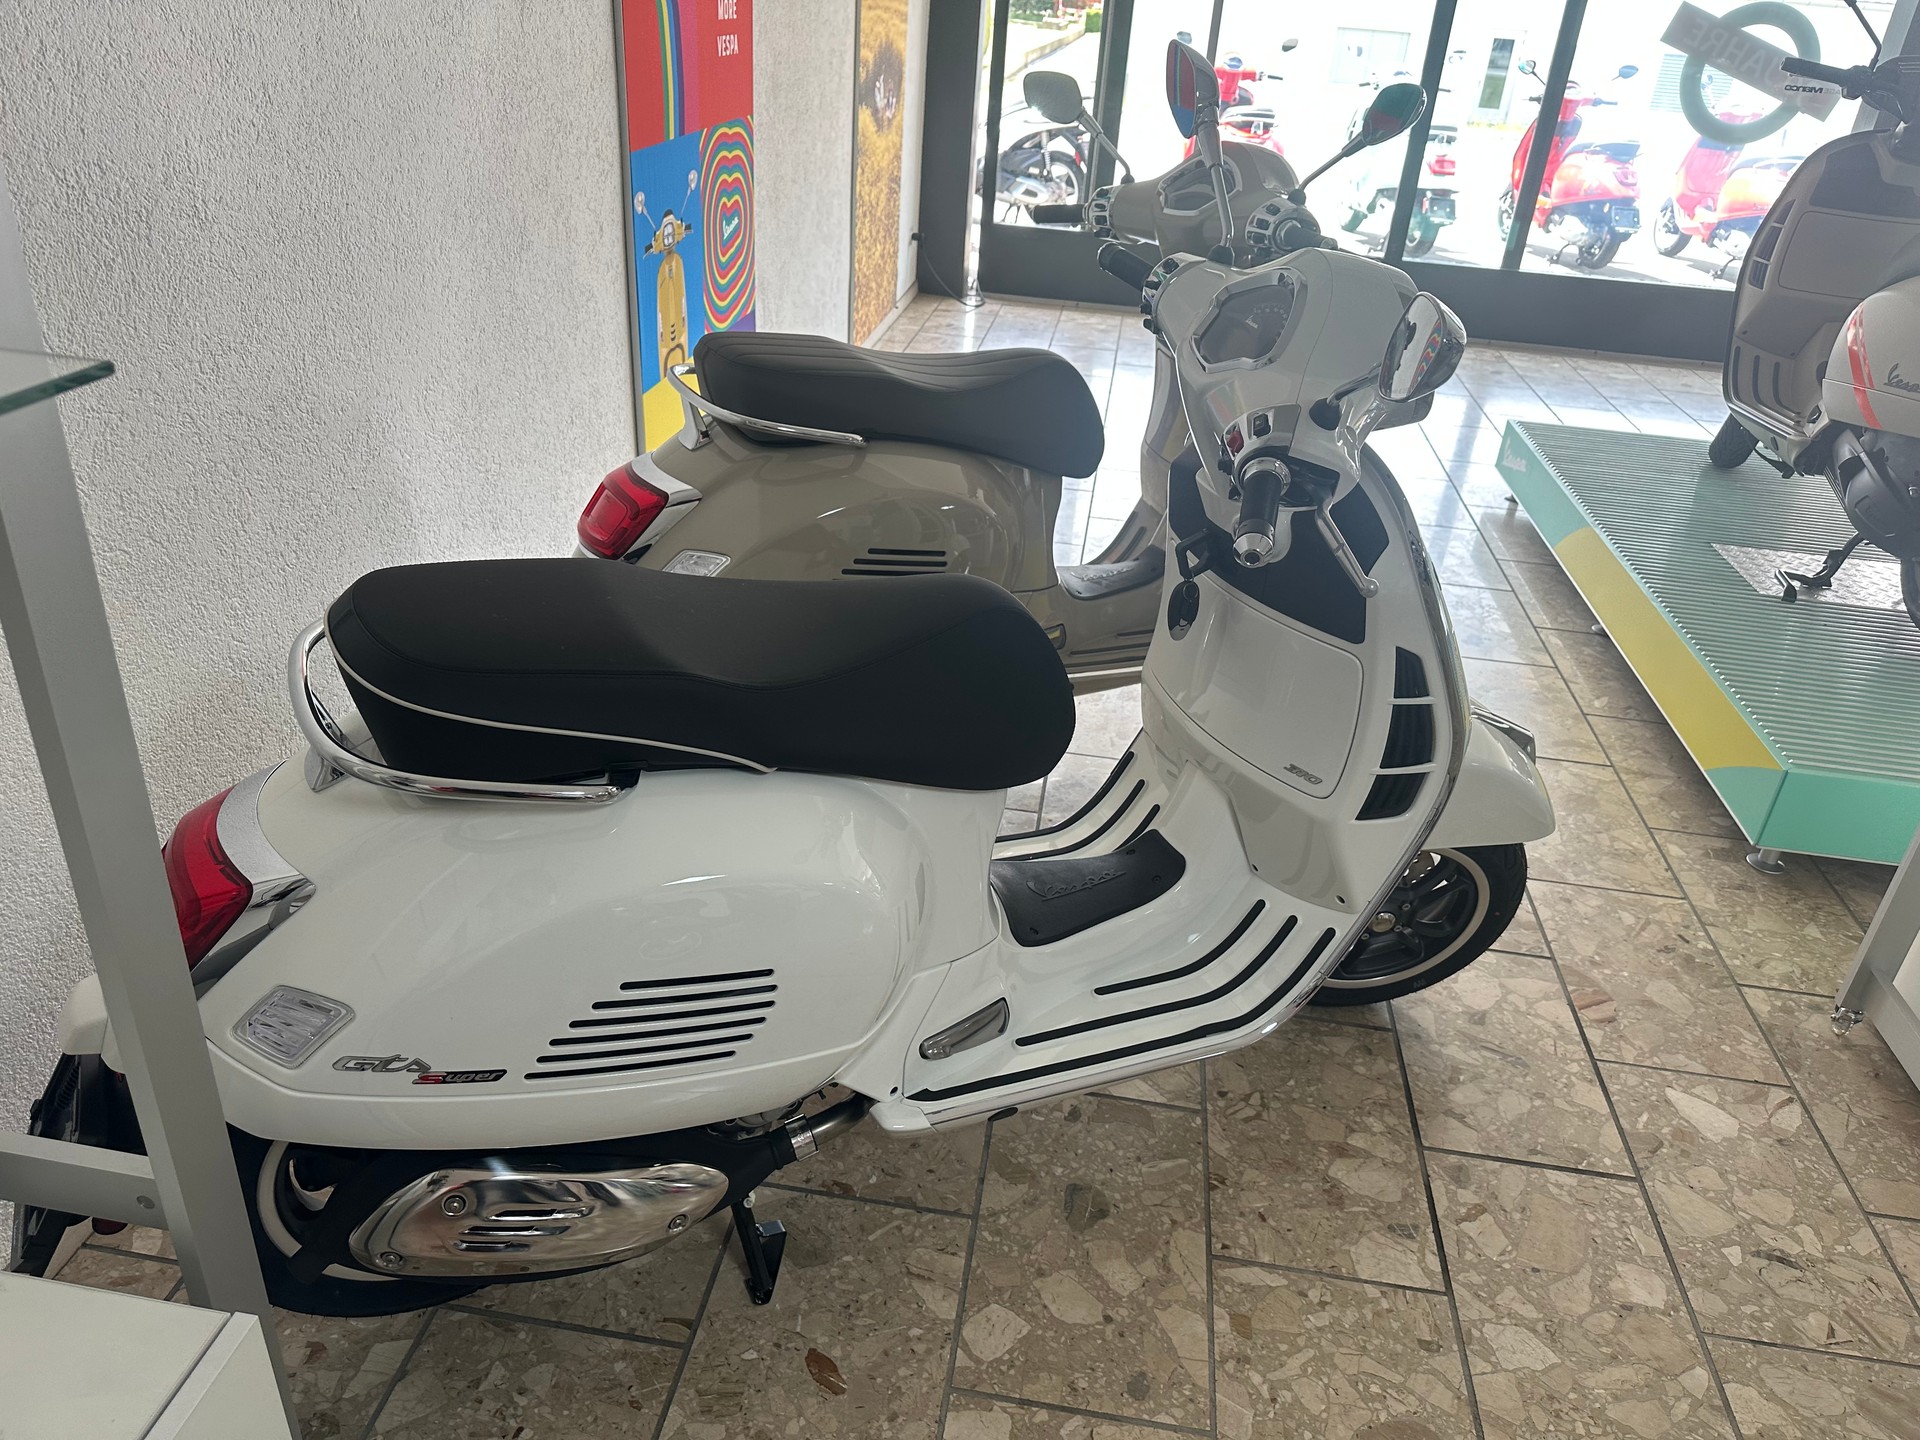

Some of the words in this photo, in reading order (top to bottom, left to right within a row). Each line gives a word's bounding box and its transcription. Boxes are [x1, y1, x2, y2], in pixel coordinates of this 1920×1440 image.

[718, 0, 737, 20] MORE
[717, 34, 738, 57] VESPA
[1883, 362, 1920, 393] Vesp
[1026, 870, 1127, 903] Vespa
